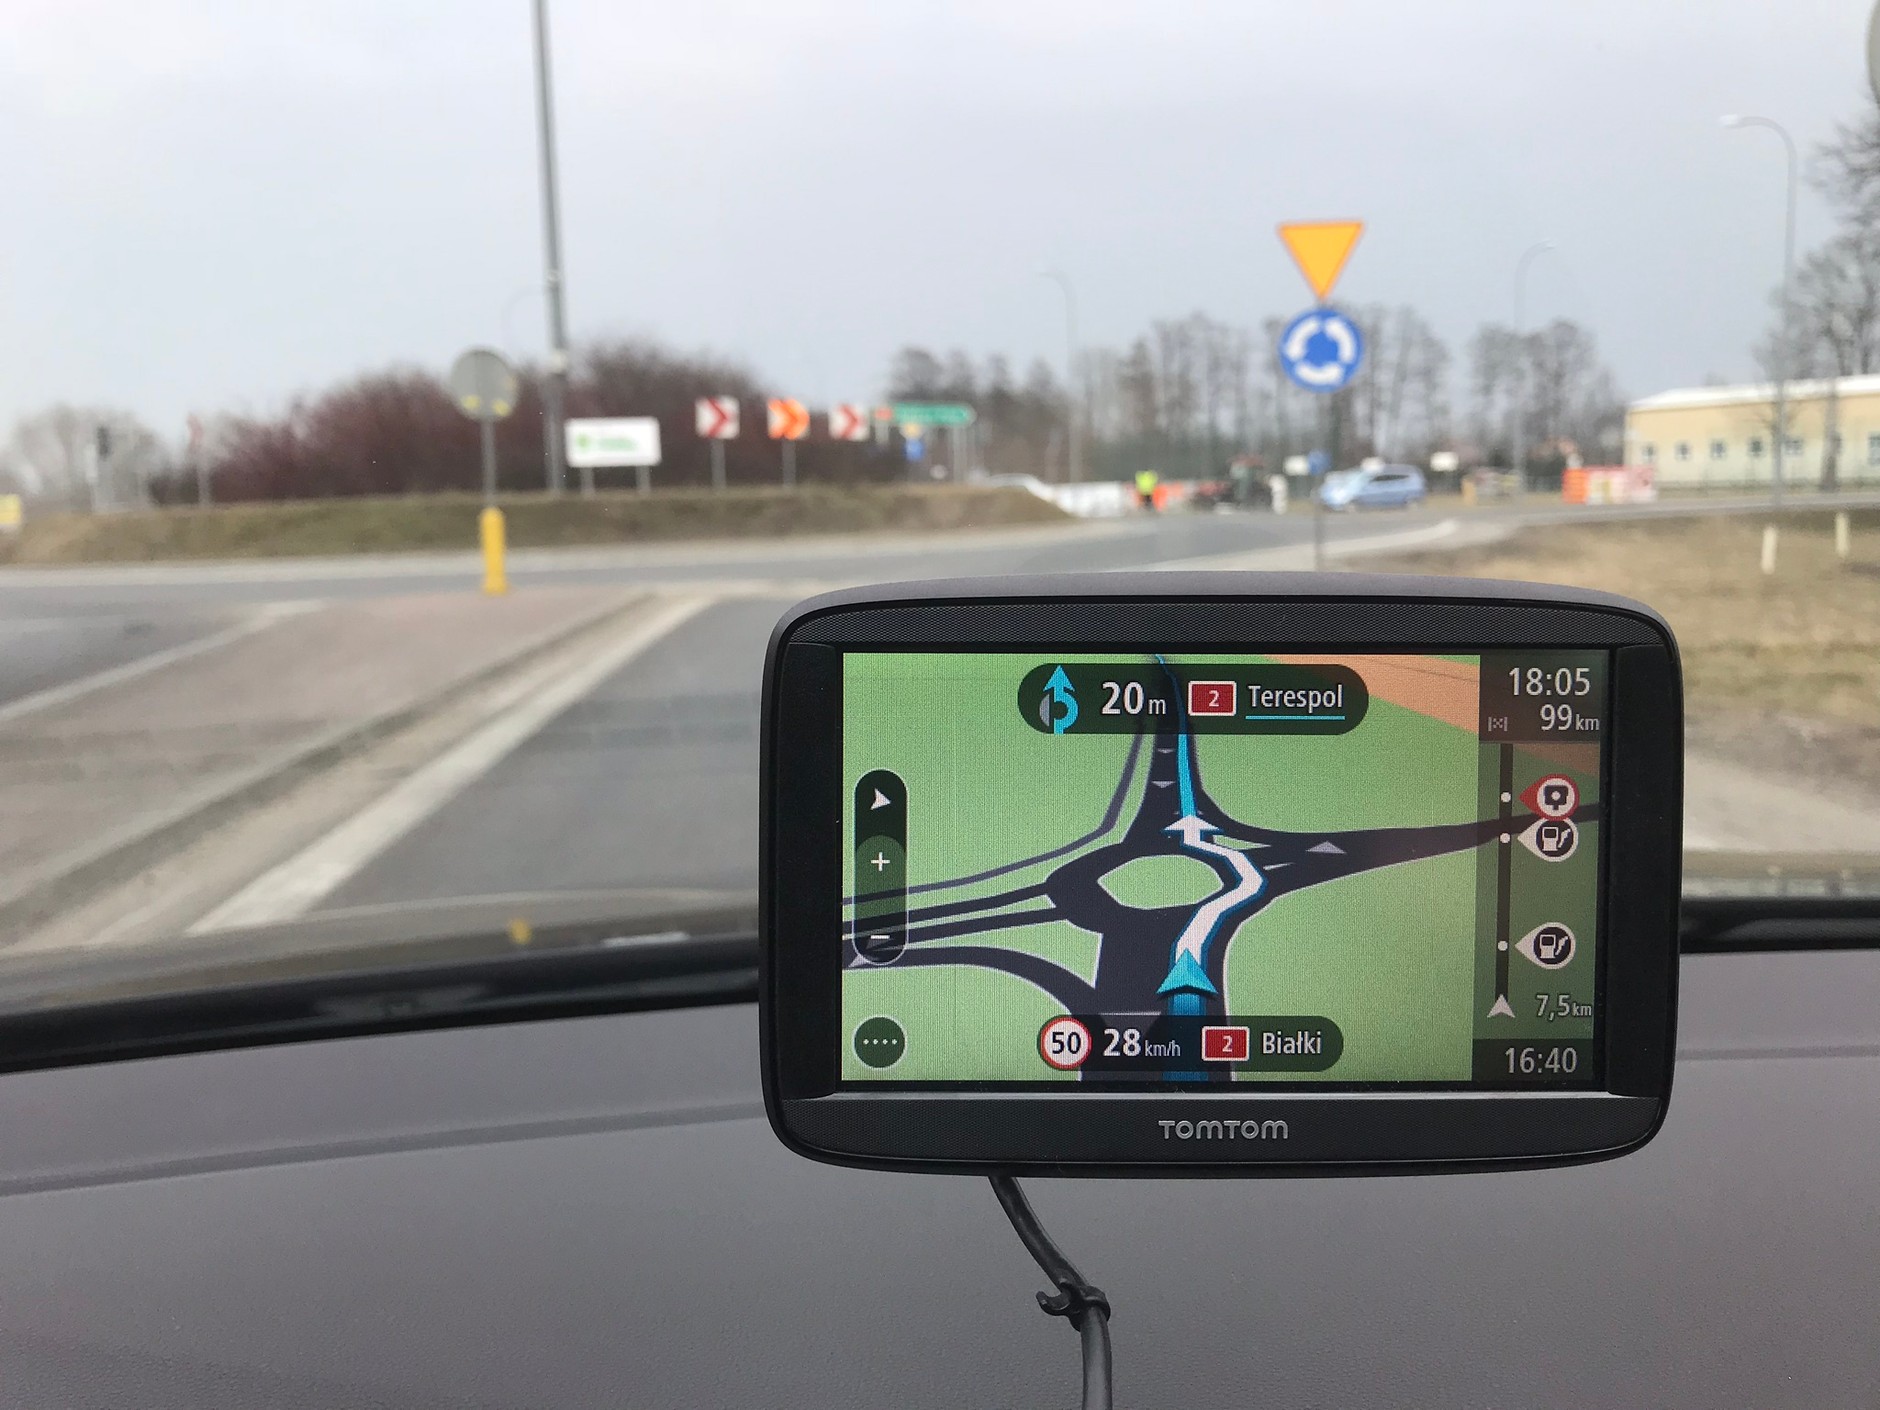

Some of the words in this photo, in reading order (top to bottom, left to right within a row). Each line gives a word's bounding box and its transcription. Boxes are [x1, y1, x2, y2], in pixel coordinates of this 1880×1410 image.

[1509, 667, 1591, 696] 18:05
[1208, 690, 1221, 708] 2
[1248, 684, 1344, 714] Terespol
[1051, 1031, 1081, 1055] 50
[1221, 1035, 1233, 1053] 2
[1261, 1030, 1322, 1055] Białki
[1505, 1047, 1578, 1074] 16:40
[1158, 1120, 1289, 1140] TOMTOM
